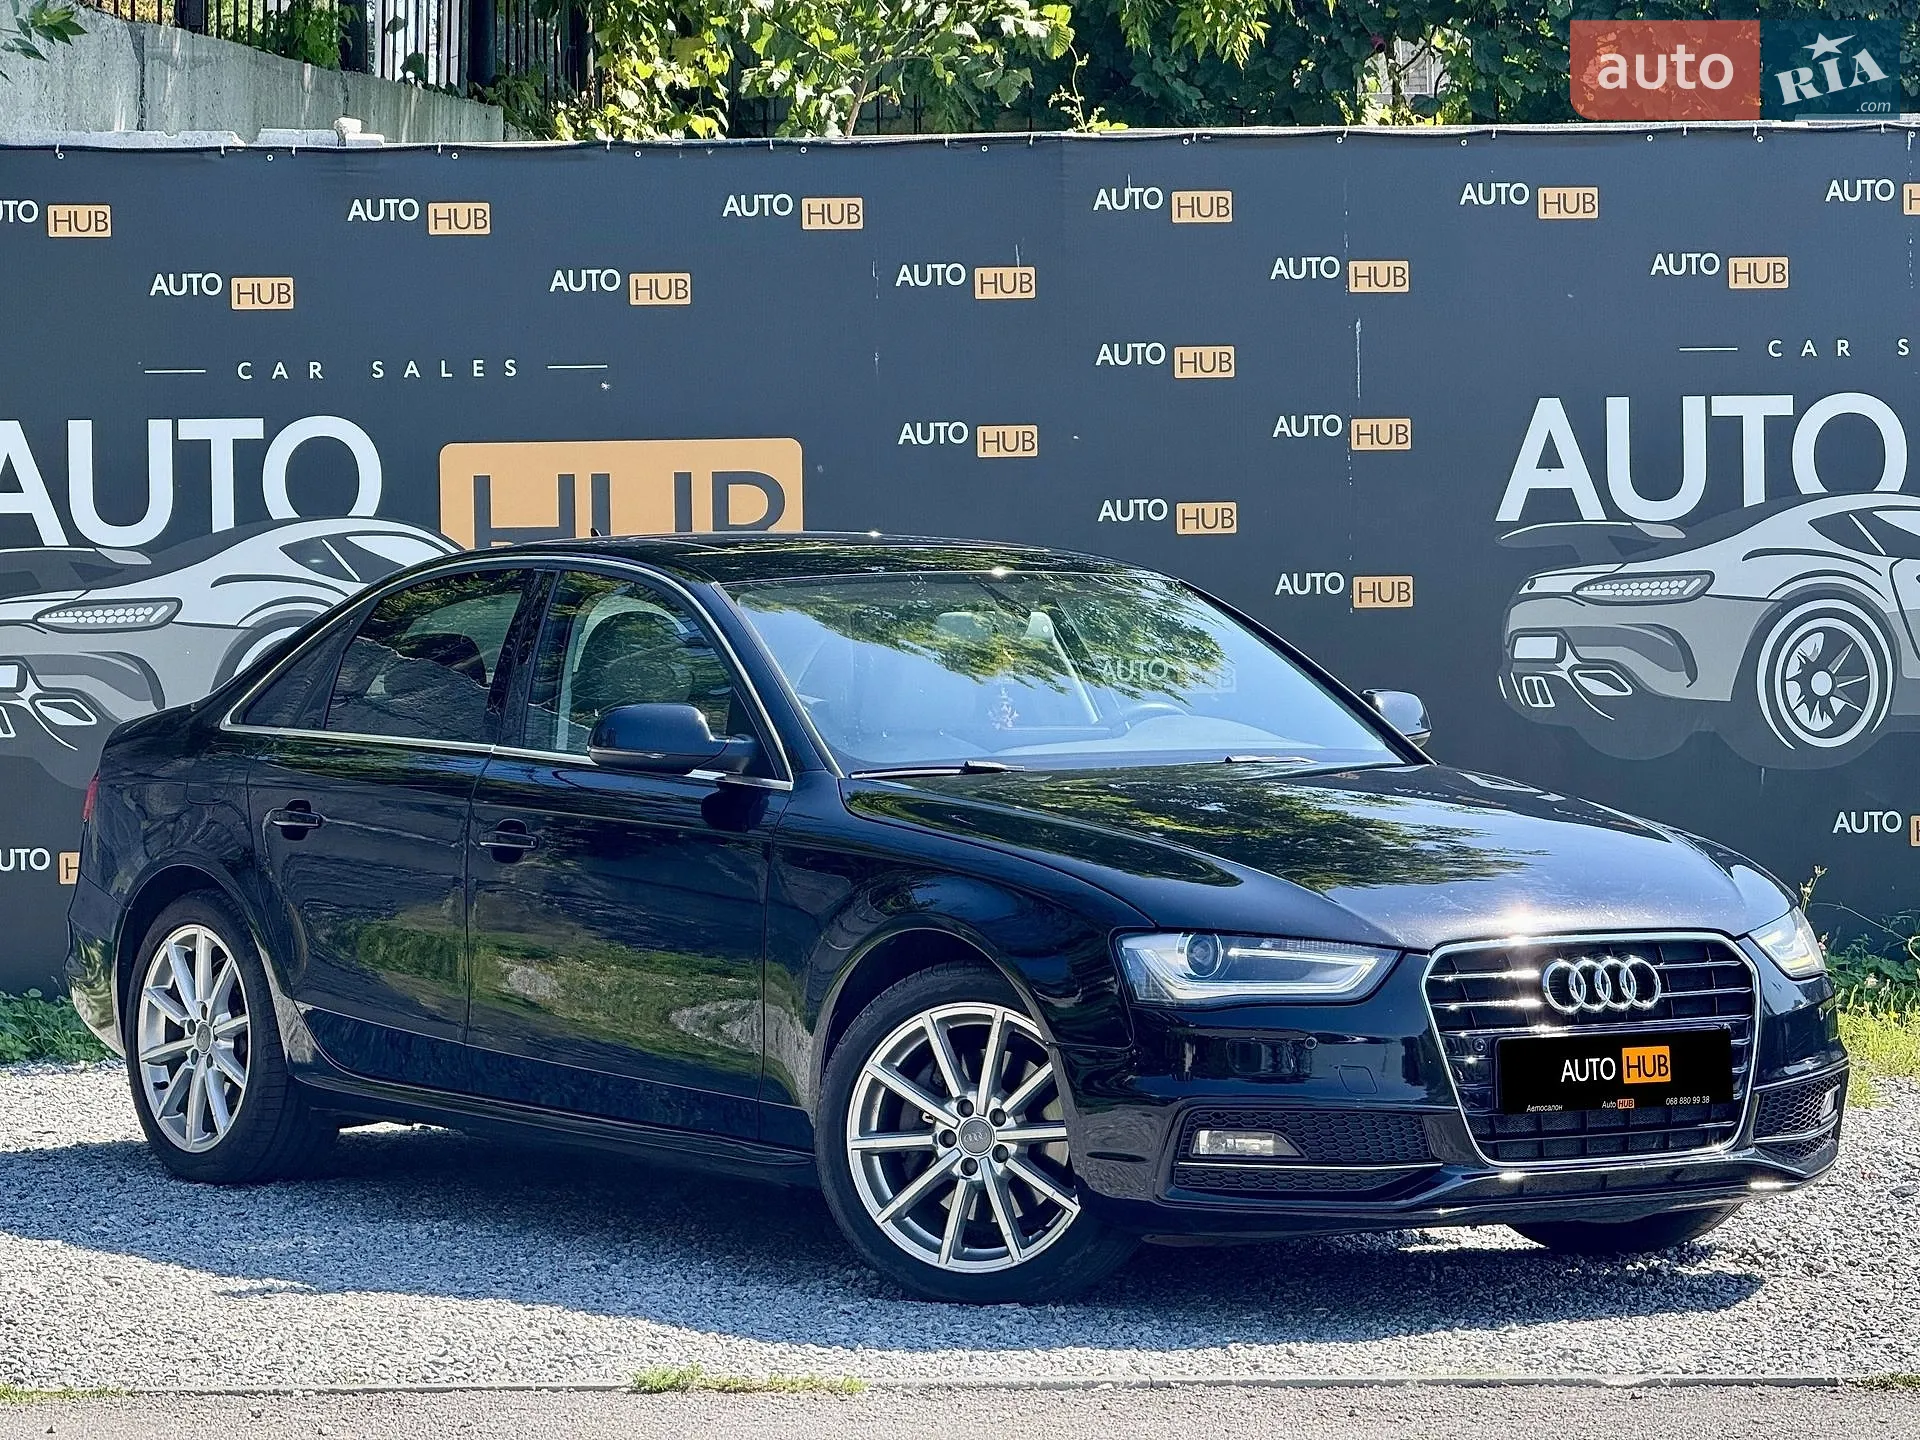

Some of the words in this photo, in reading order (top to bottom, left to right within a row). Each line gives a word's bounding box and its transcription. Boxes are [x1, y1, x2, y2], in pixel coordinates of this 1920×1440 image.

[1093, 186, 1164, 211] AUTO
[1177, 196, 1230, 219] HUB
[1460, 183, 1530, 206] AUTO
[1543, 192, 1596, 215] HUB
[1826, 179, 1895, 202] AUTO
[0, 199, 39, 223] TO
[53, 210, 109, 233] HUB
[347, 198, 420, 222] AUTO
[433, 207, 488, 230] HUB
[722, 193, 794, 217] AUTO
[807, 203, 861, 225] HUB
[549, 268, 621, 292] AUTO
[635, 278, 689, 301] HUB
[895, 262, 966, 287] AUTO
[980, 272, 1033, 295] HUB
[1270, 255, 1341, 280] AUTO
[1354, 266, 1407, 288] HUB
[1650, 252, 1721, 276] AUTO
[1733, 262, 1787, 285] HUB
[149, 272, 223, 296] AUTO
[236, 282, 292, 305] HUB
[1095, 342, 1166, 366] AUTO
[1179, 351, 1233, 374] HUB
[1768, 339, 1851, 358] CAR
[237, 361, 324, 380] CAR
[372, 359, 517, 379] SALES
[897, 421, 969, 445] AUTO
[982, 430, 1036, 453] HUB
[1272, 414, 1343, 438] AUTO
[1356, 423, 1409, 446] HUB
[1496, 392, 1908, 522] AUTO
[1097, 498, 1168, 522] AUTO
[1181, 507, 1235, 530] HUB
[1274, 571, 1345, 596] AUTO
[1358, 581, 1411, 604] HUB
[1832, 810, 1902, 834] AUTO
[1560, 1057, 1616, 1083] AUTO
[1625, 1054, 1669, 1078] HUB
[1602, 1100, 1617, 1109] Auto
[1618, 1100, 1634, 1108] HUB
